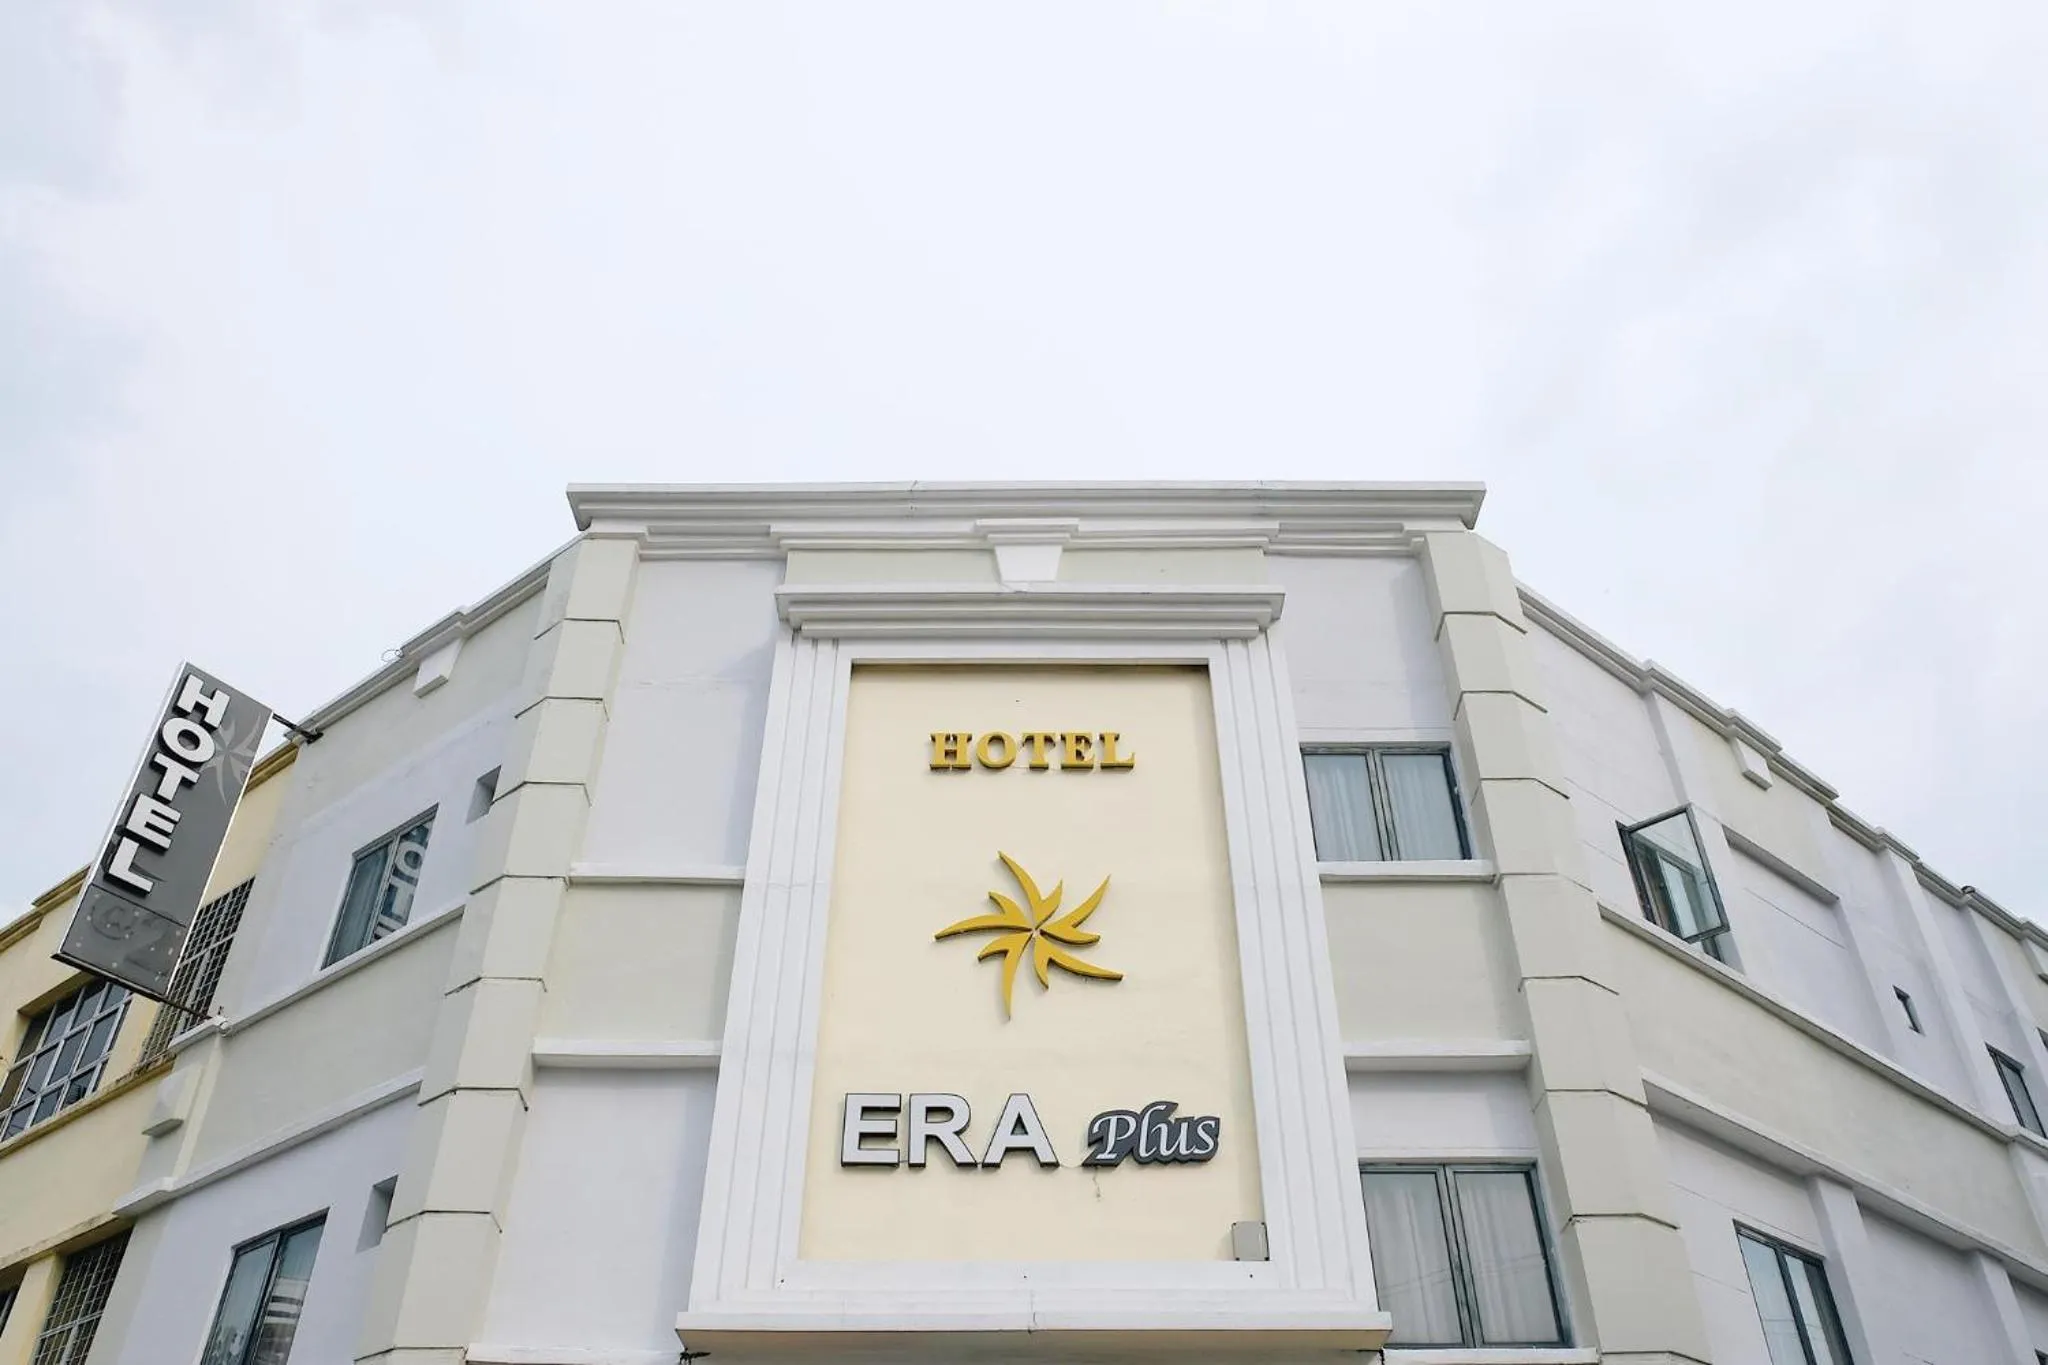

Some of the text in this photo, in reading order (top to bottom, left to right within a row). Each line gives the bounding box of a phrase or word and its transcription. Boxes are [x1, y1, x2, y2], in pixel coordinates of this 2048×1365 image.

[108, 674, 230, 892] HOTEL
[929, 732, 1135, 769] HOTEL
[841, 1093, 1219, 1167] ERA Plus
